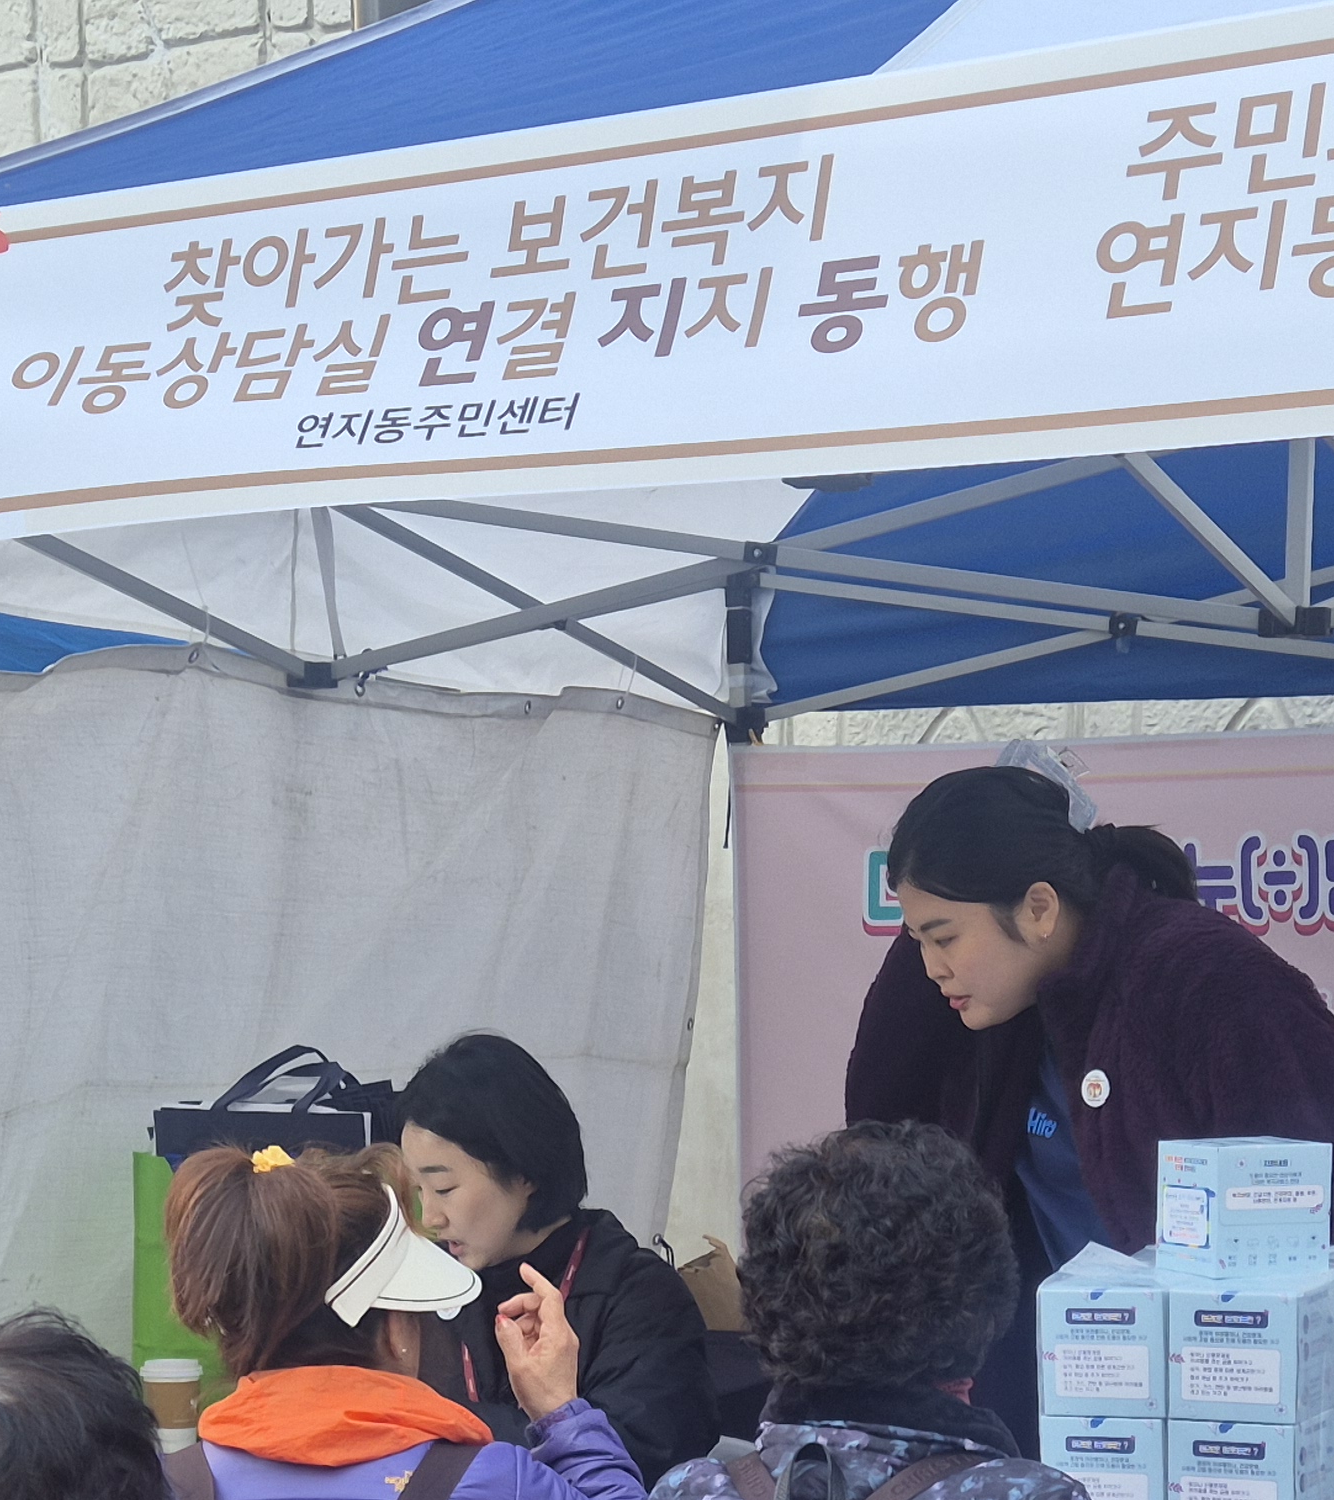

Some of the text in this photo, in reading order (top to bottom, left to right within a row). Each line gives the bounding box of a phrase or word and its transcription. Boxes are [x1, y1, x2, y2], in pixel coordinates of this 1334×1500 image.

[10, 239, 986, 414] 이동상담실 연결 지지 동행
[163, 154, 835, 332] 찾아가는 보건복지
[295, 392, 579, 449] 연지동주민센터
